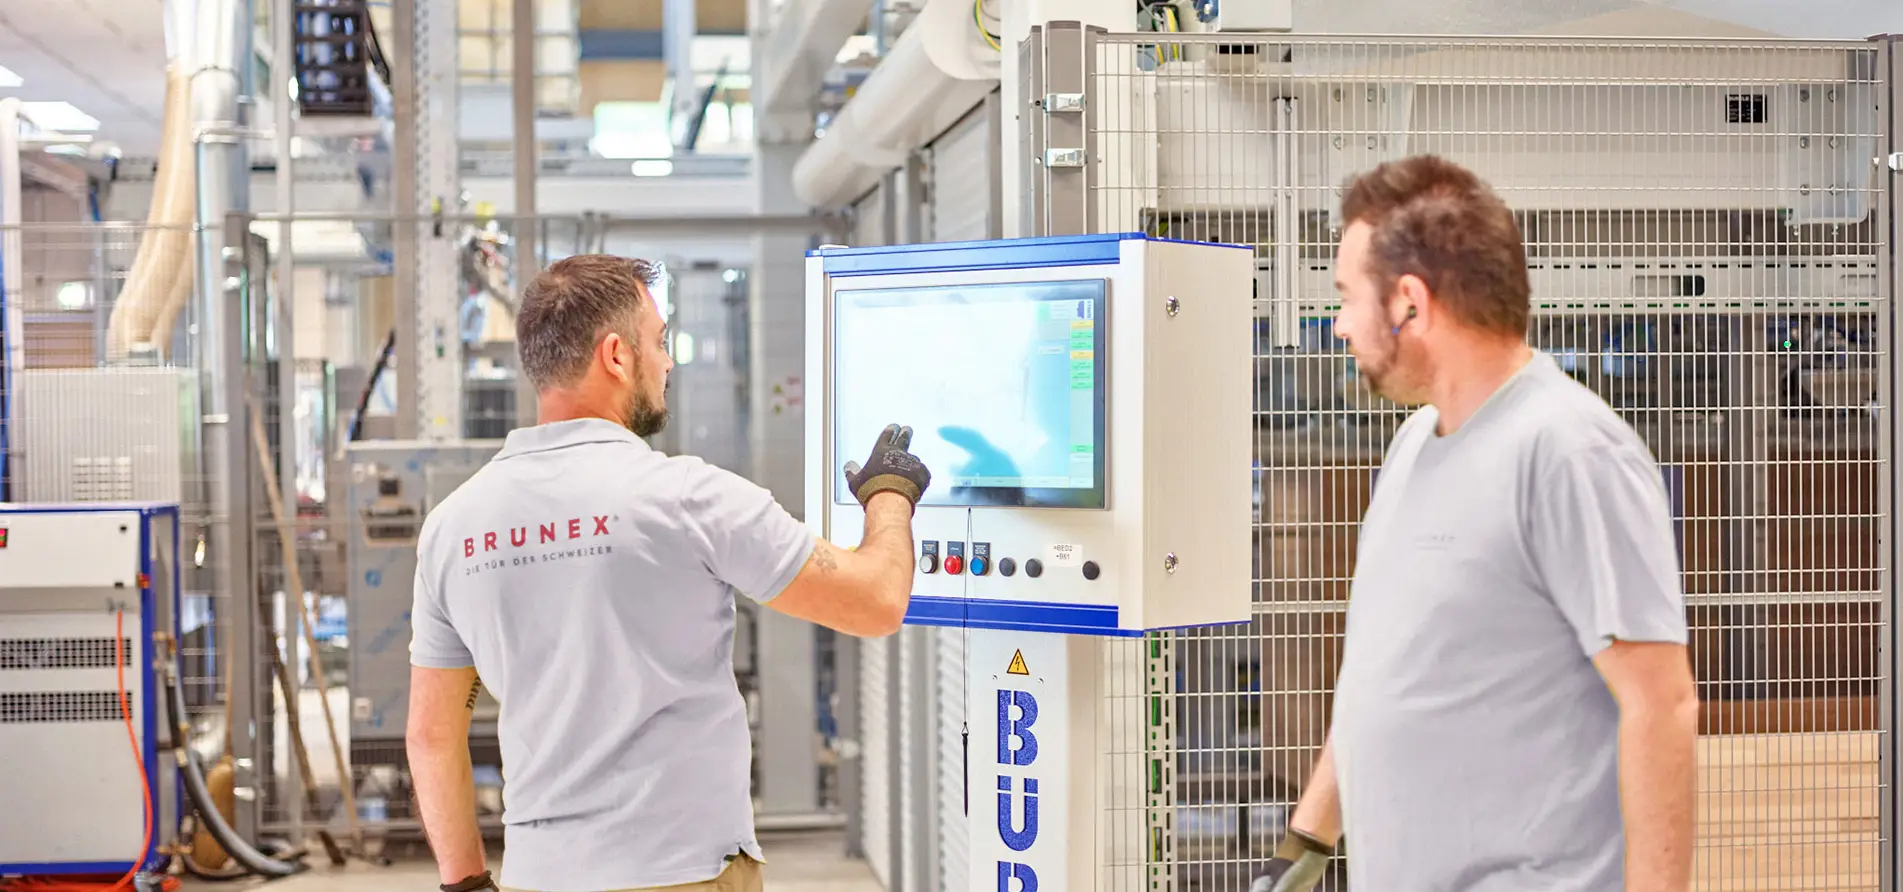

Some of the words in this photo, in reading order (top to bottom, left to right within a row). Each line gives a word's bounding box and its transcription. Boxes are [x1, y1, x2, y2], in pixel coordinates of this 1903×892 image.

[464, 515, 610, 558] BRUNEX
[485, 560, 506, 570] TÜR
[513, 555, 536, 567] DER
[542, 545, 613, 563] SCHWEIZER
